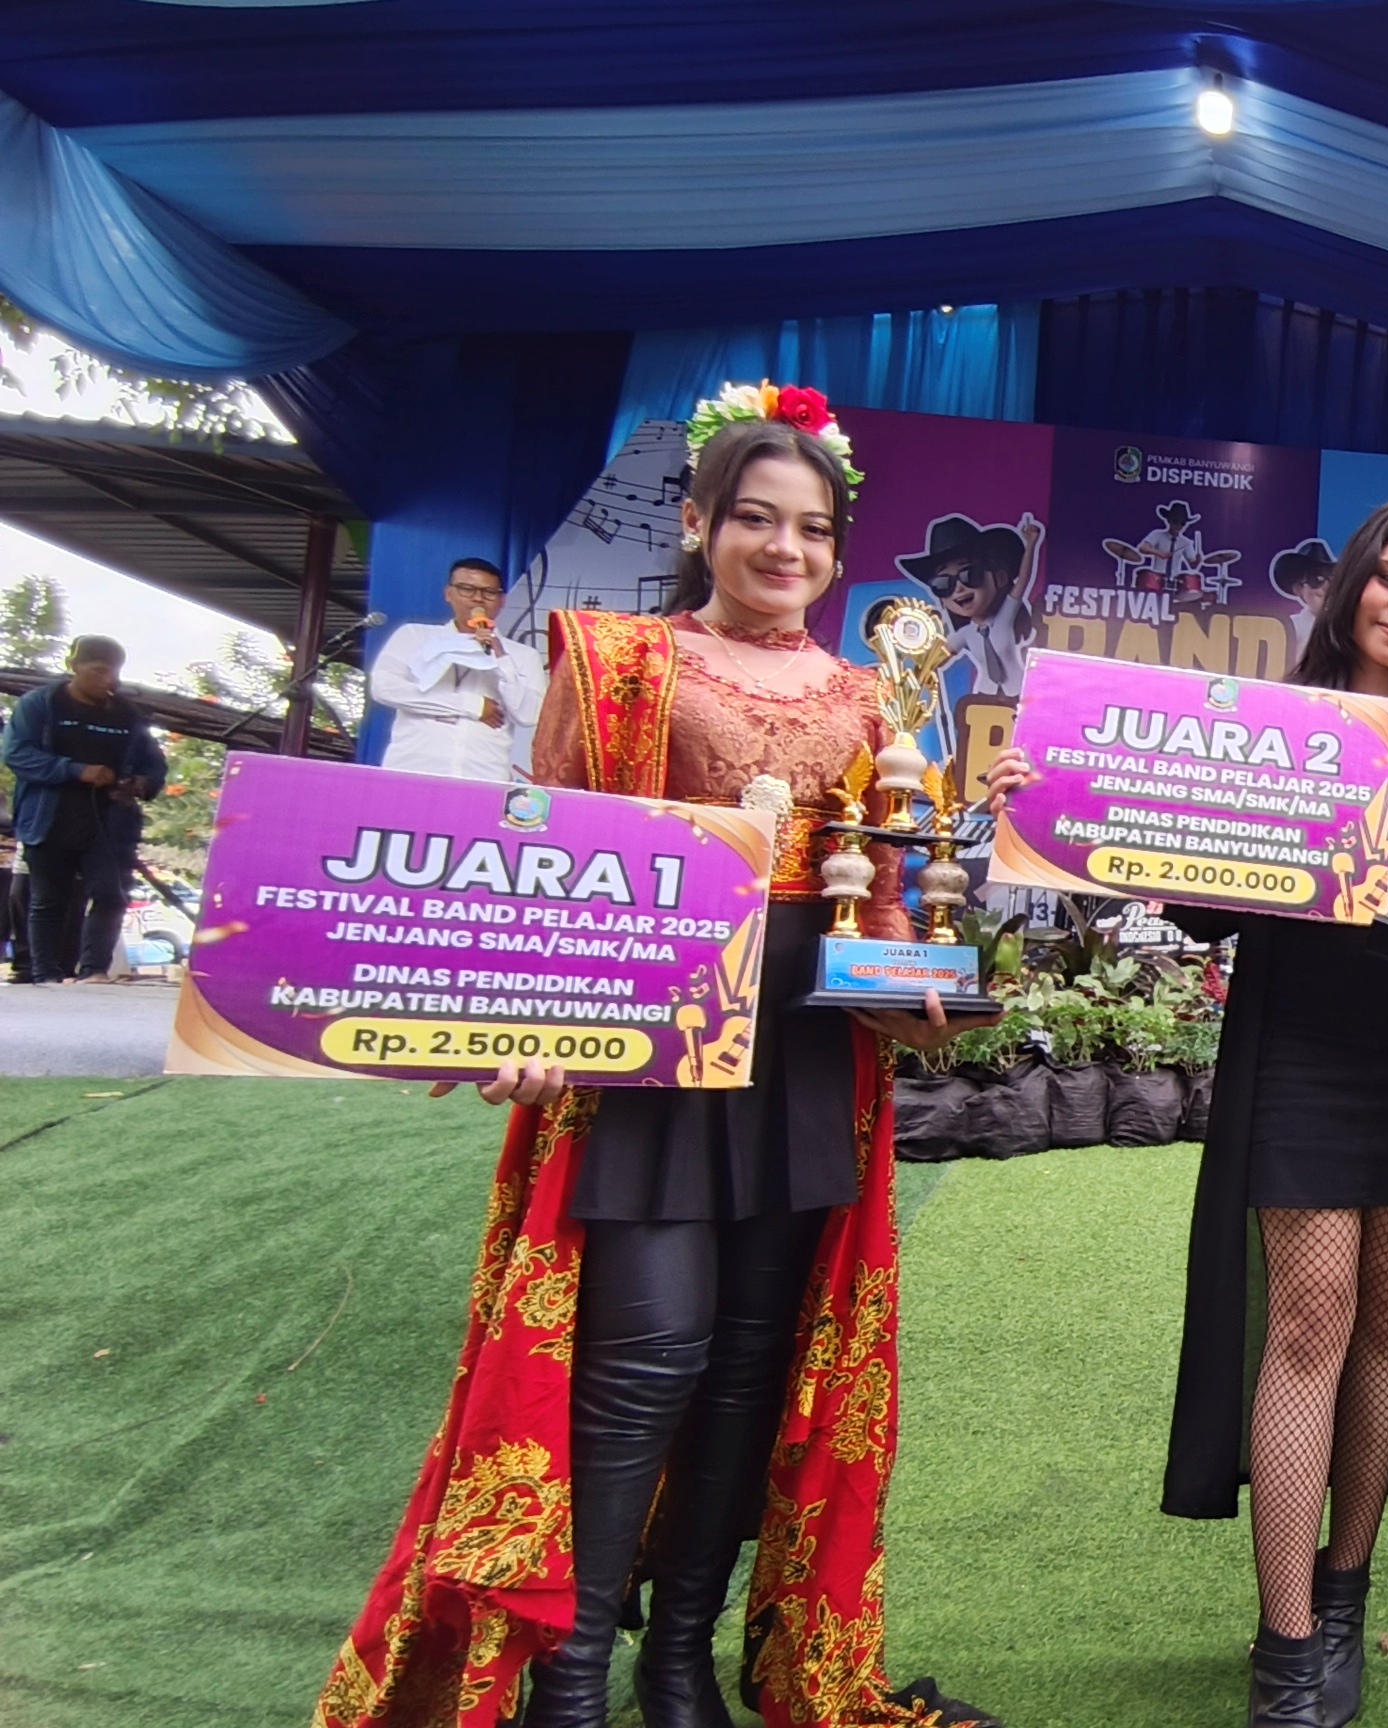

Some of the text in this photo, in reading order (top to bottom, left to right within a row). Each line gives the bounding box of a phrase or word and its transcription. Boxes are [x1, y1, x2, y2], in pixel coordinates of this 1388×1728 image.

[1147, 455, 1255, 471] PEMKAB BANYUWANGI
[1147, 467, 1254, 490] DISPENDIK
[1044, 584, 1176, 625] FESTIVAL
[1083, 706, 1342, 775] JUARA 2
[1045, 747, 1372, 802] FESTIVAL BAND PELAJAR 2025
[1090, 775, 1332, 819] JENJANG SMA/SMK/MA
[1054, 820, 1330, 867] KABUPATEN BANYUWANGI
[1108, 806, 1302, 844] DINAS PENDIDIKAN
[322, 826, 685, 909] JUARA 1
[1107, 856, 1297, 894] Rp. 2.000.000
[256, 886, 731, 940] FESTIVAL BAND PELAJAR 2025
[1120, 901, 1176, 931] Pear
[326, 922, 677, 962] JENJANG SMA/SMK/MA
[883, 948, 928, 958] JUARA 1
[353, 963, 634, 997] DINAS PENDIDIKAN
[851, 964, 957, 979] BAND PELAJAR 2025
[270, 985, 672, 1023] KABUPATEN BANYUWANGI
[352, 1028, 626, 1061] Rp. 2.500.000
